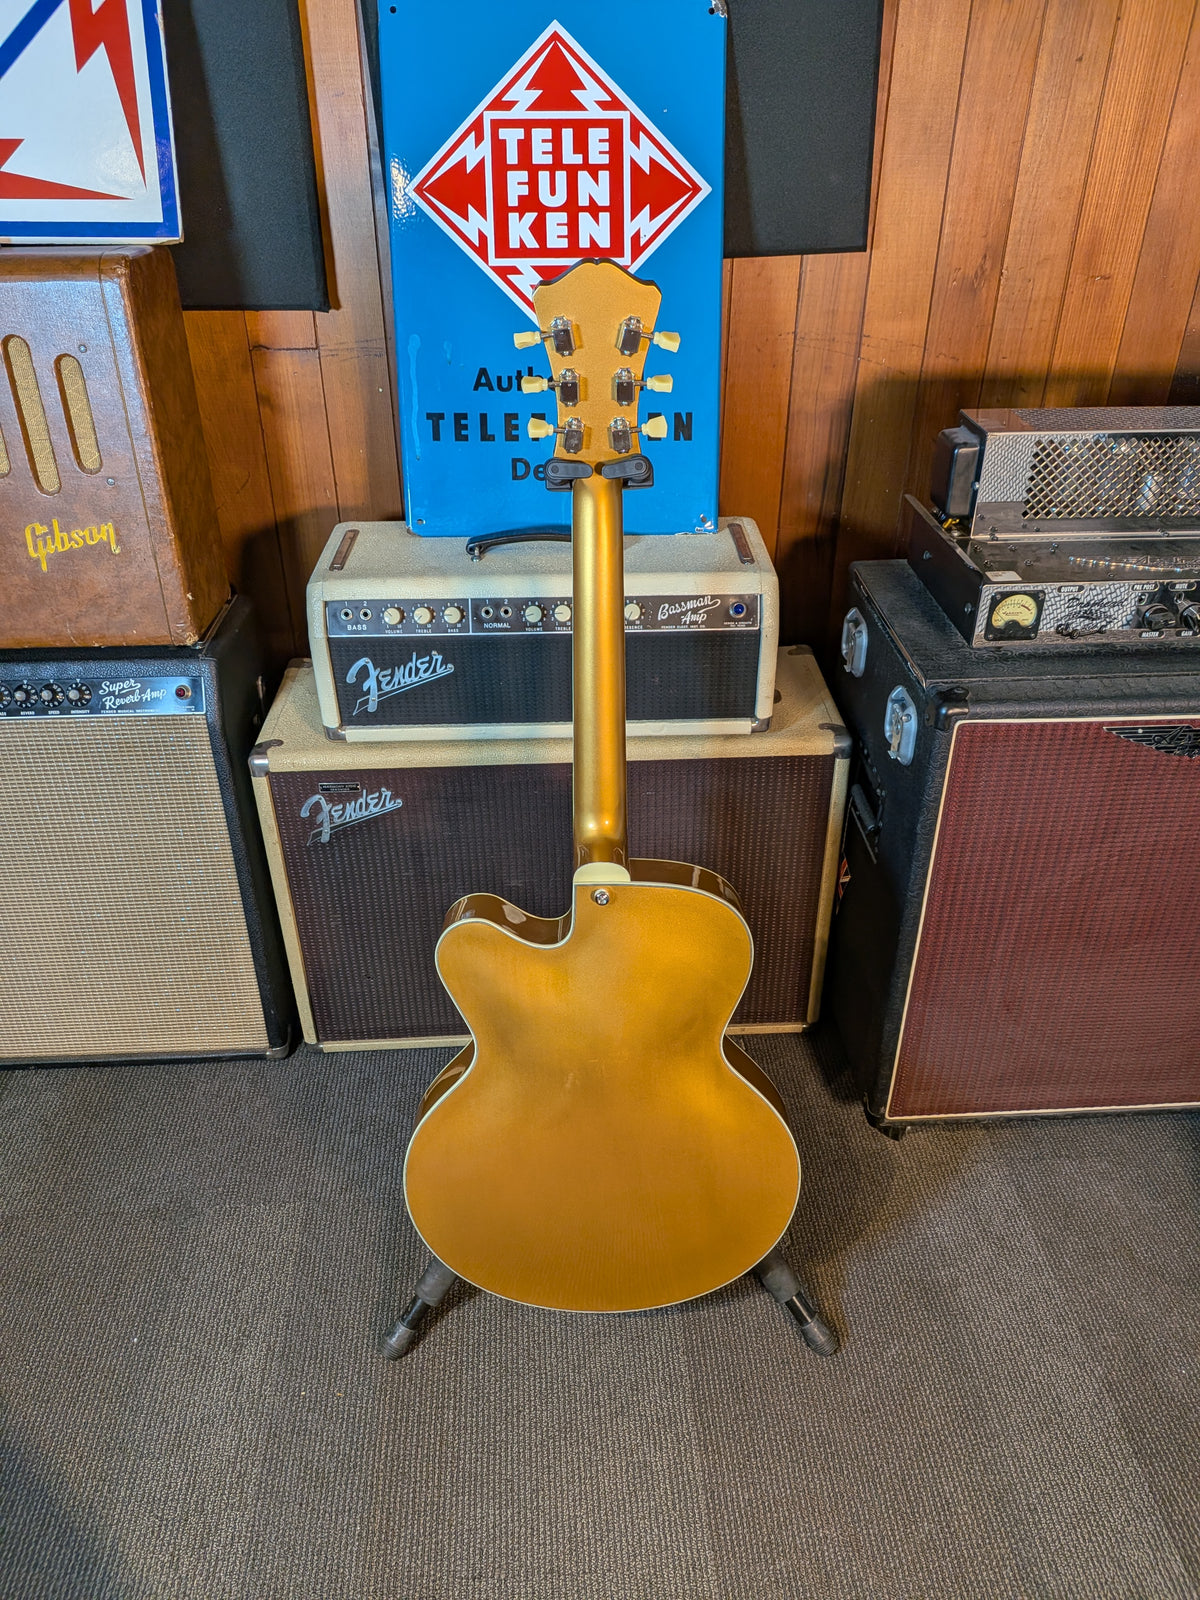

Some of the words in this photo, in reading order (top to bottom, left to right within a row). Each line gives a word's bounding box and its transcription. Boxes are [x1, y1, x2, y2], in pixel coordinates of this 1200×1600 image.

[499, 128, 610, 165] TELE
[507, 170, 611, 207] FUN
[508, 212, 611, 249] KEN
[24, 518, 121, 572] Gibson
[657, 595, 721, 620] Bassman
[99, 678, 142, 696] Super
[345, 650, 455, 716] Fender
[300, 787, 403, 846] Fender
